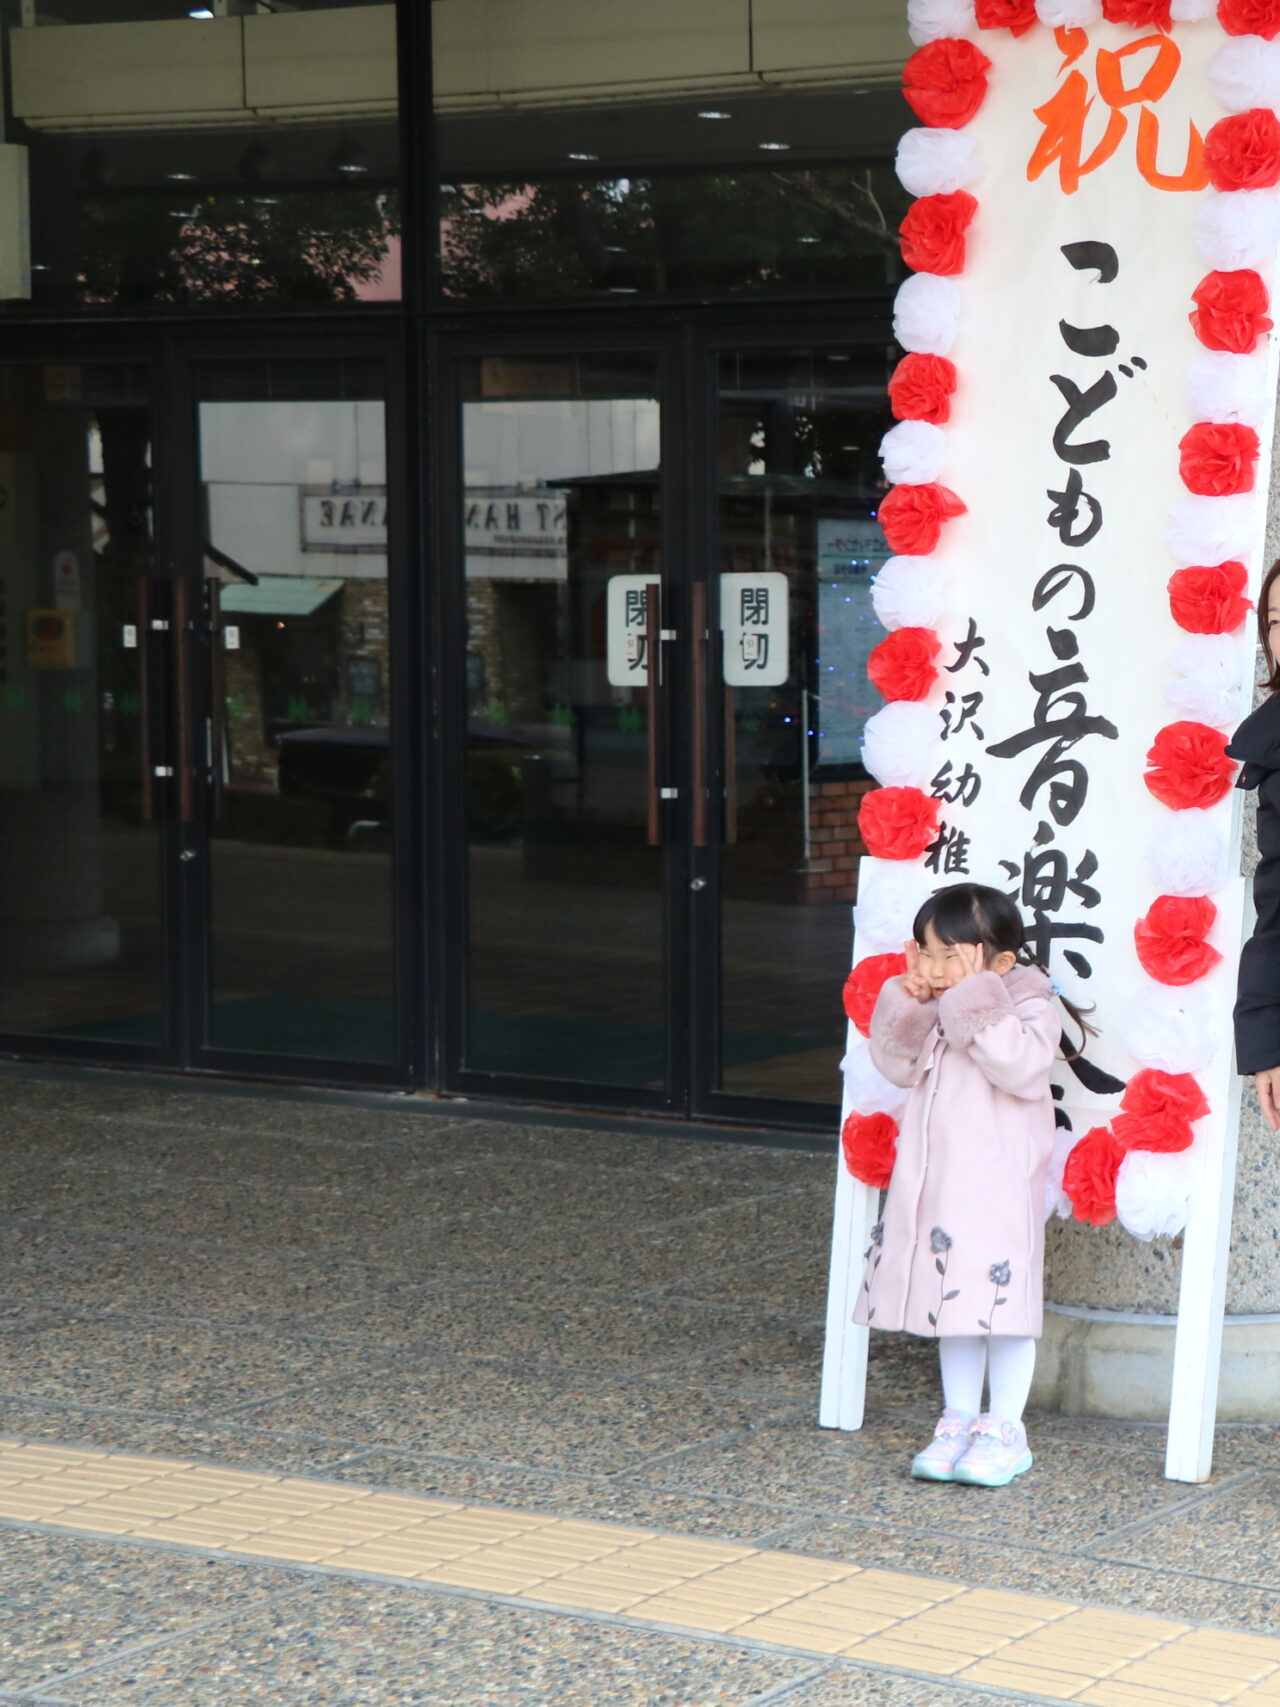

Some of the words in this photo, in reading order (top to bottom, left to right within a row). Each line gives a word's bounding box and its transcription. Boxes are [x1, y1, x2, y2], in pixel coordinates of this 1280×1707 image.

[1026, 26, 1209, 196] 祝
[924, 617, 989, 893] 大沢幼稚
[985, 240, 1147, 1132] こどもの音楽
